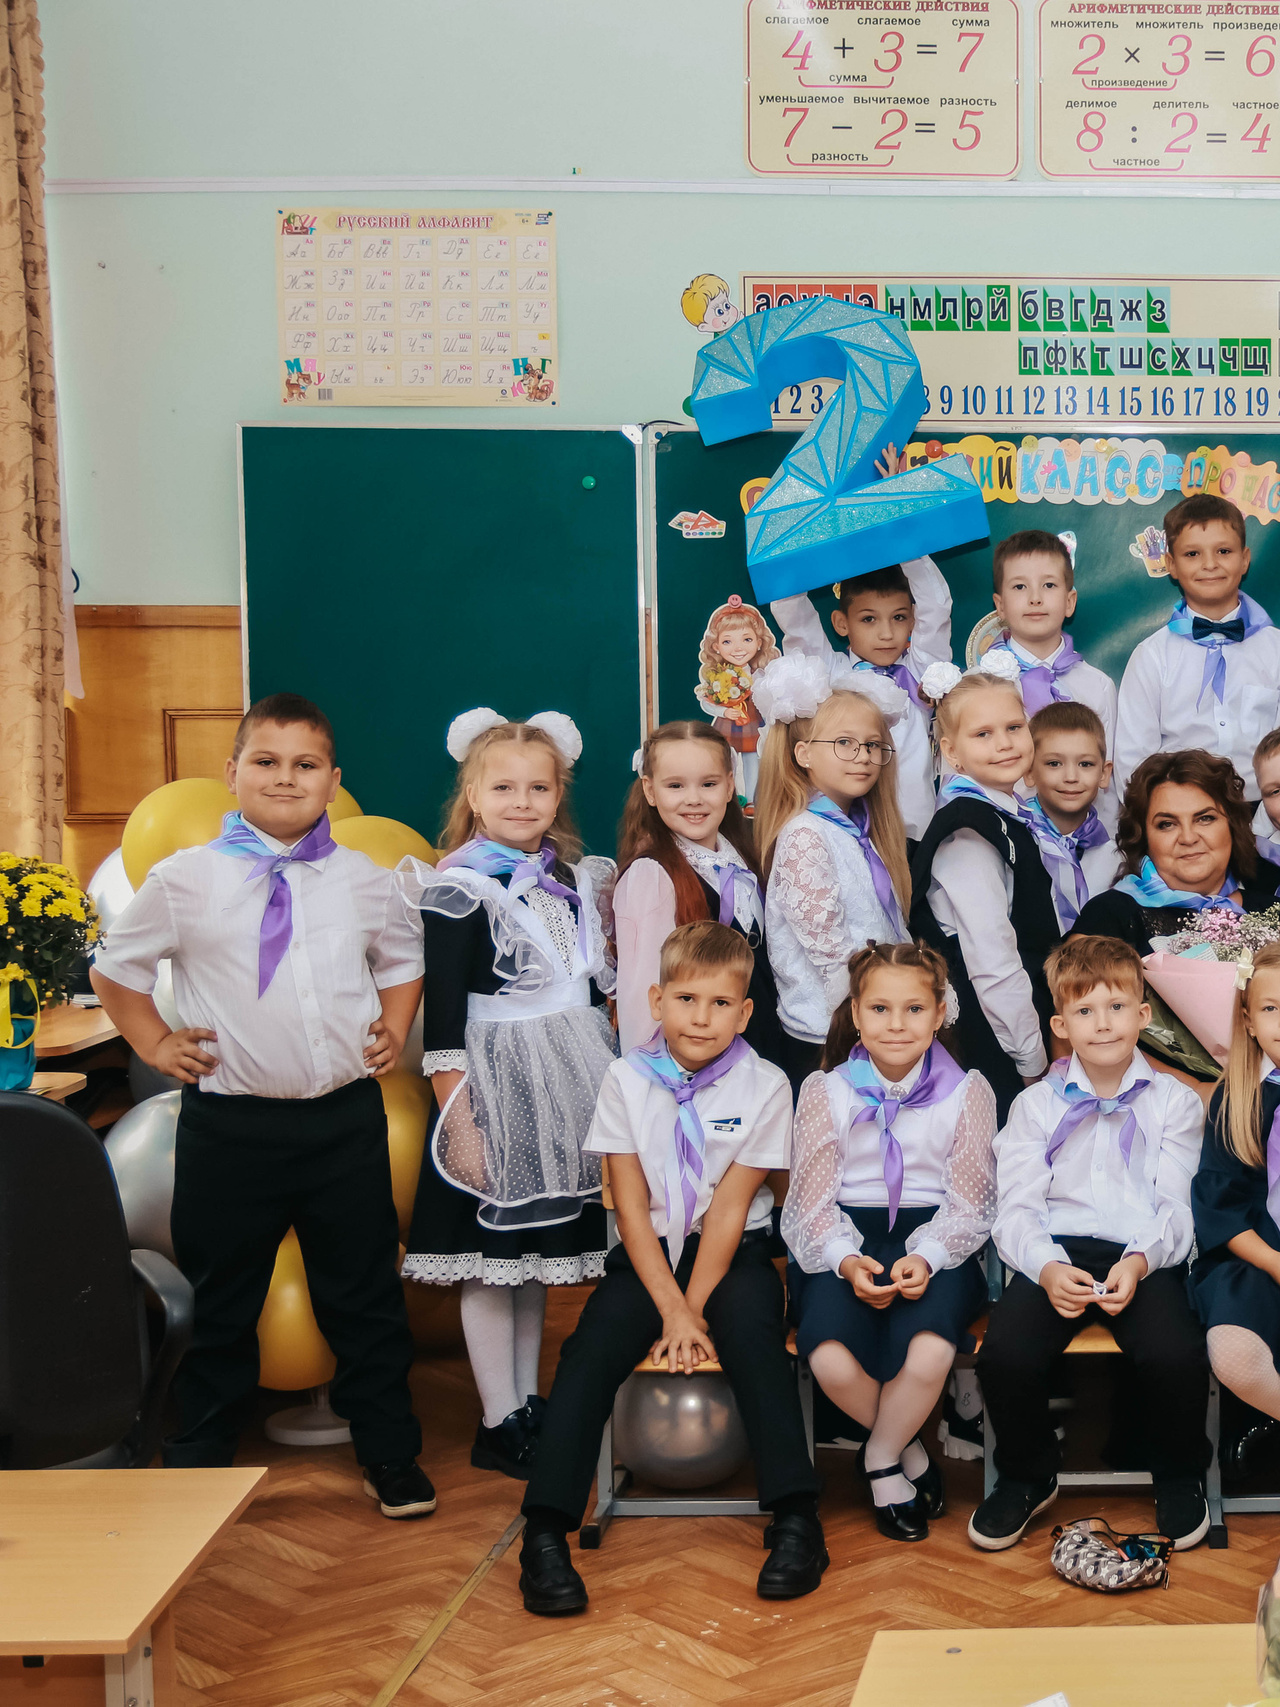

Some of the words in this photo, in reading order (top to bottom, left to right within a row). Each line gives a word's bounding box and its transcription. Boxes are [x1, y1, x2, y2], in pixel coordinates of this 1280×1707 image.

[776, 0, 910, 11] АФМЕТИЧЕСКИЕ
[916, 0, 989, 12] ДЕЙСТВИЯ
[1068, 3, 1202, 14] АРИФМЕТИЧЕСКИЕ
[1206, 4, 1279, 15] ДЕЙСТВИЯ
[766, 16, 829, 24] слагаемое
[857, 16, 921, 25] слагаемое
[952, 18, 989, 27] сумма
[1051, 21, 1118, 29] множитель
[1135, 21, 1203, 30] множитель
[782, 30, 813, 70] 4
[874, 32, 904, 72] 3
[957, 32, 984, 72] 7
[1072, 34, 1105, 75] 2
[1162, 35, 1192, 75] 3
[1246, 35, 1276, 76] 6
[830, 73, 867, 83] сумма
[1091, 79, 1167, 88] произведение
[759, 96, 844, 105] уменьшаемое
[854, 96, 929, 104] вычитаемое
[940, 97, 996, 108] разность
[1066, 100, 1117, 109] делимое
[1153, 101, 1209, 110] делитель
[1233, 101, 1279, 109] частное
[782, 108, 809, 147] 7
[875, 109, 908, 150] 2
[953, 110, 984, 150] 5
[1076, 111, 1106, 152] 8
[1164, 112, 1198, 153] 2
[1240, 113, 1271, 153] 4
[812, 152, 868, 162] разность
[1113, 158, 1160, 166] частное
[337, 213, 410, 231] РУССКИЙ
[418, 217, 493, 228] АЛФАВИТ
[790, 385, 802, 414] 2
[811, 385, 824, 414] 3
[940, 385, 952, 414] 9
[962, 385, 986, 415] 10
[996, 385, 1014, 414] 11
[1023, 386, 1045, 415] 12
[1054, 386, 1077, 415] 13
[1087, 386, 1109, 416] 14
[1119, 386, 1142, 416] 15
[1151, 386, 1174, 416] 16
[1183, 387, 1204, 416] 17
[1214, 387, 1236, 416] 18
[1245, 387, 1268, 417] 19
[692, 296, 992, 604] 2
[1019, 447, 1165, 499] КЛАСС
[1187, 457, 1236, 494] ПРО
